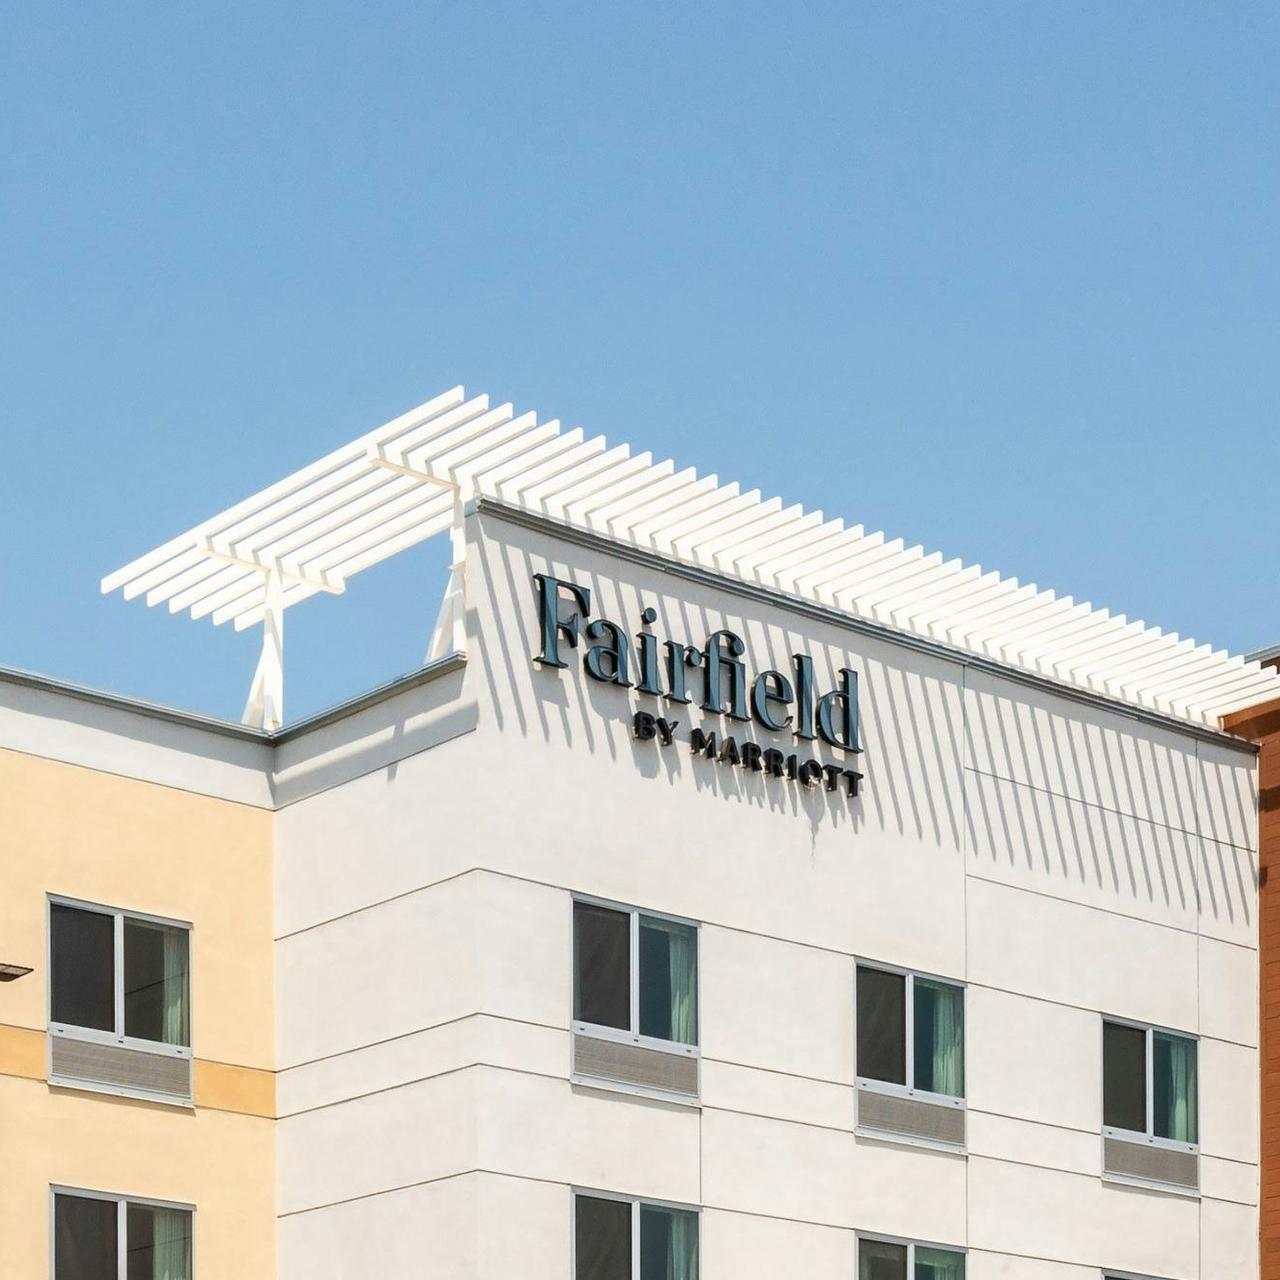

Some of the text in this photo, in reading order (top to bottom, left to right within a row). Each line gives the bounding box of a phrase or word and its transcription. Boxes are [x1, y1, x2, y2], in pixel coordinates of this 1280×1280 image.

[533, 573, 864, 754] Fairfield
[633, 711, 865, 798] BY MARRIOTT
